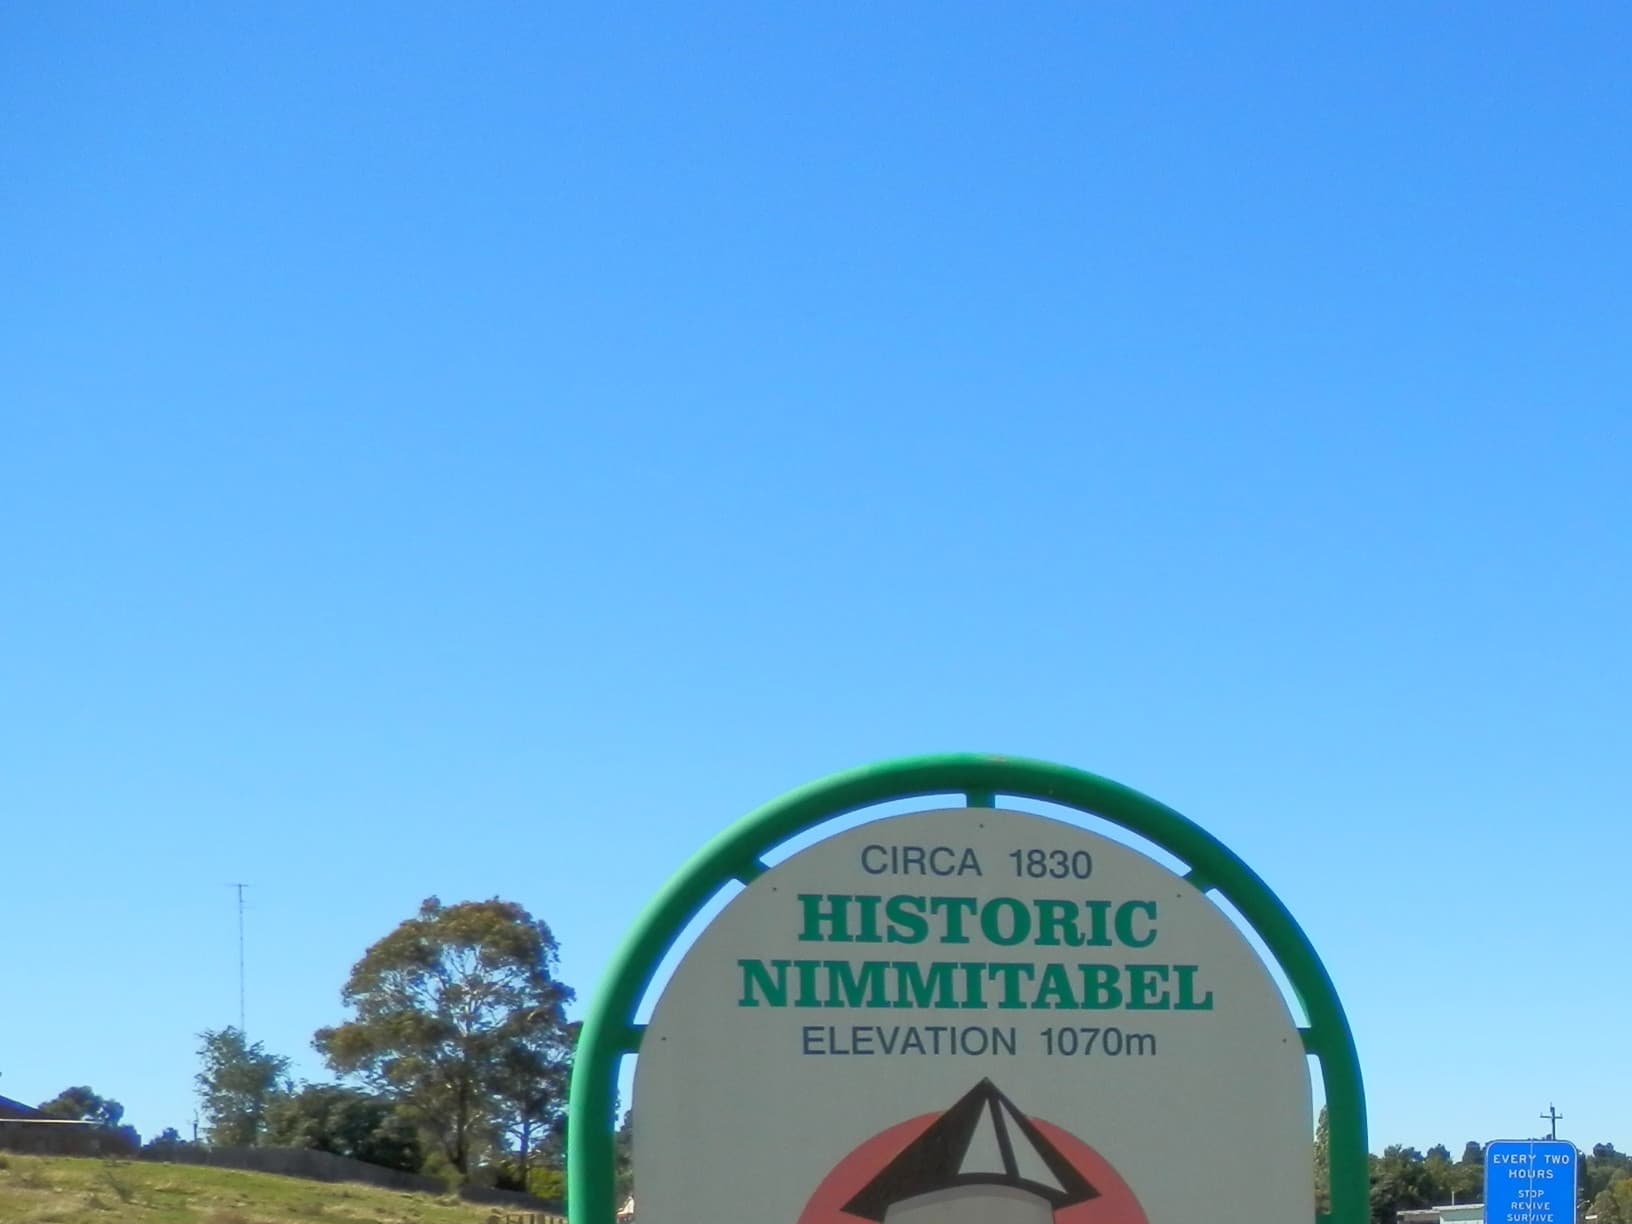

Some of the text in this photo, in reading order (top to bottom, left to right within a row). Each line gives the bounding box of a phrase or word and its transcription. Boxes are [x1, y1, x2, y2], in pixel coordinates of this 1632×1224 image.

[861, 844, 1093, 880] CIRCA 1830
[797, 893, 1158, 949] HISTORIC
[737, 959, 1214, 1011] NIMMITABEL
[802, 1025, 1157, 1057] ELEVATION 1070m
[1493, 1154, 1570, 1165] EVERY TWO
[1508, 1169, 1554, 1179] HOURS
[1518, 1189, 1545, 1198] STOP
[1511, 1201, 1551, 1210] REVIVE
[1506, 1213, 1554, 1222] SURVIVE
